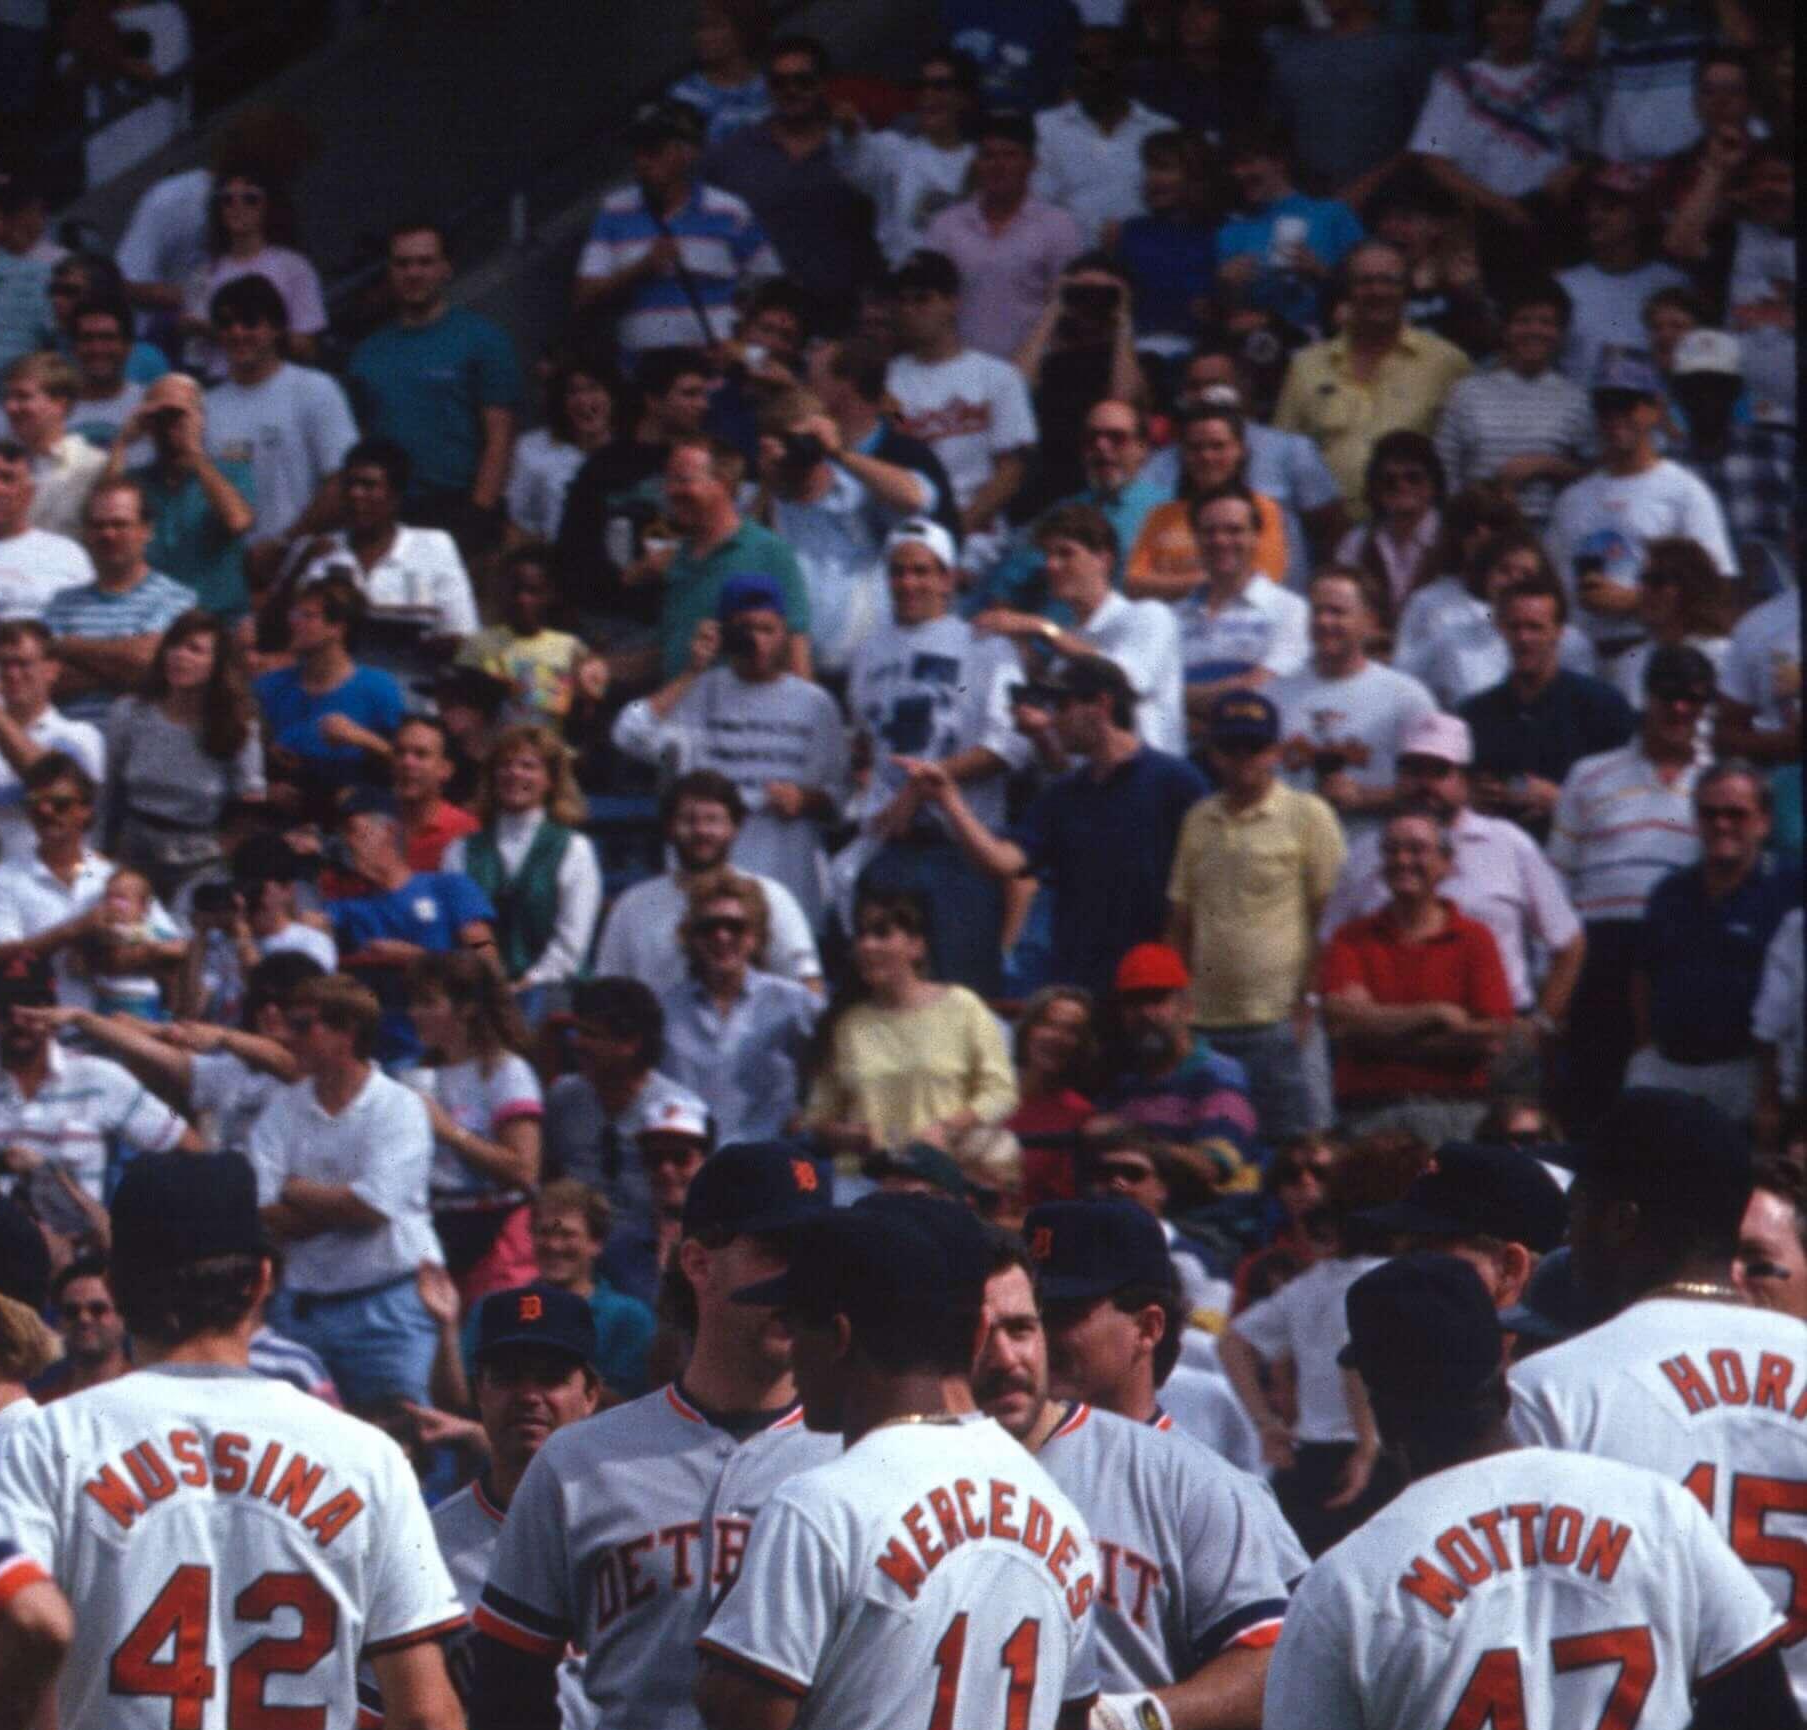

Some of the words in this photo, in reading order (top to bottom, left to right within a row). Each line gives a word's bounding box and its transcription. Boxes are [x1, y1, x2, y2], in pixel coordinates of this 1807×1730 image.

[83, 1428, 366, 1549] MUSSINA
[596, 1518, 753, 1632] DETR
[875, 1477, 1094, 1622] MERCEDES
[1399, 1502, 1633, 1619] MOTTON
